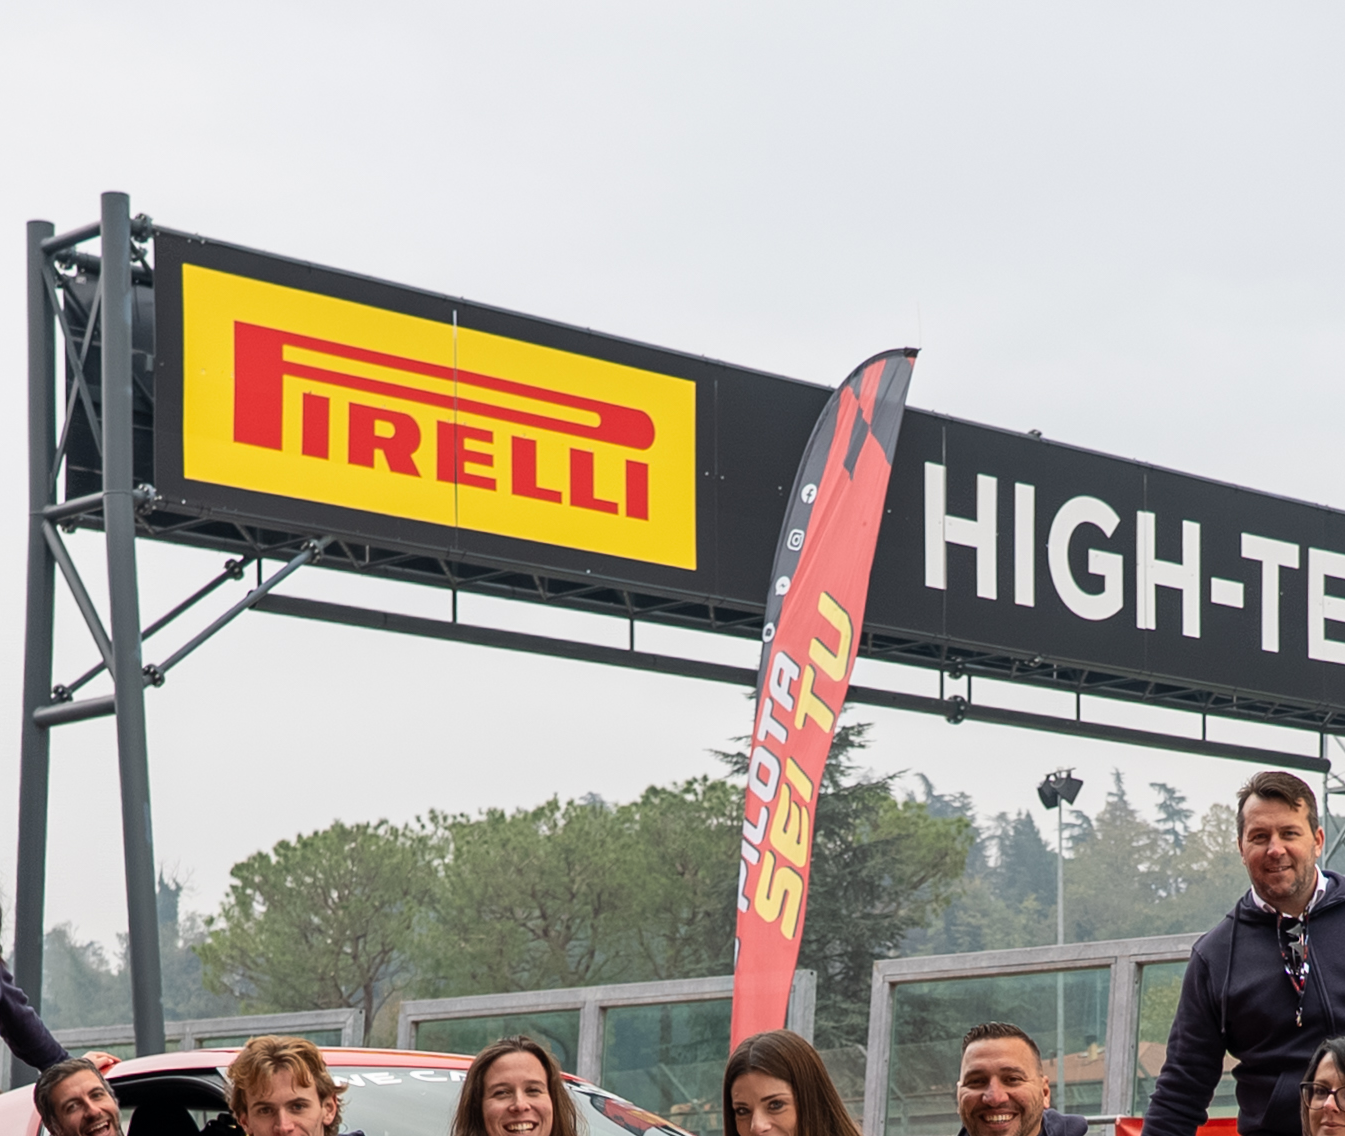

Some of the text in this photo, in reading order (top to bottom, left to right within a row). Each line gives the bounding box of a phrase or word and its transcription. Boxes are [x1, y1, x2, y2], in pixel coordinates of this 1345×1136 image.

[234, 320, 655, 521] PIRELLI
[754, 590, 853, 940] SEI TU
